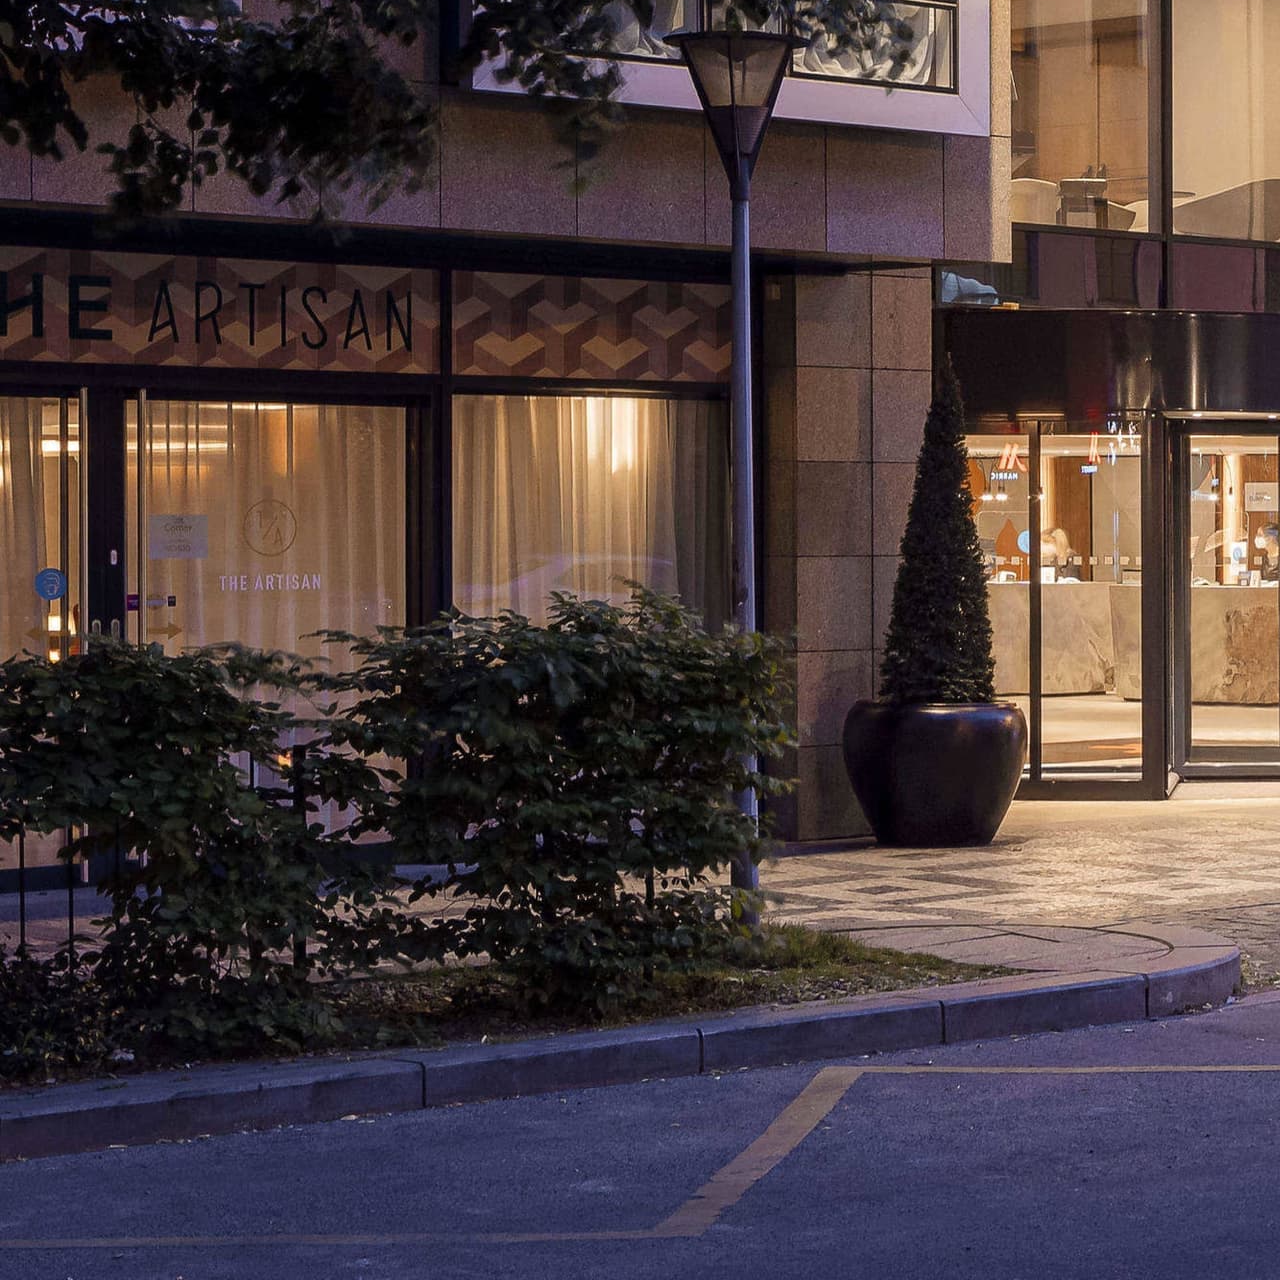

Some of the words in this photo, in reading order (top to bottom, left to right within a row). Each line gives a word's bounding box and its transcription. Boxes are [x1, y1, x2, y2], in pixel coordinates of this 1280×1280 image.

[147, 279, 413, 352] ARTISAN
[219, 575, 247, 592] THE
[254, 574, 322, 591] ARTISAN
